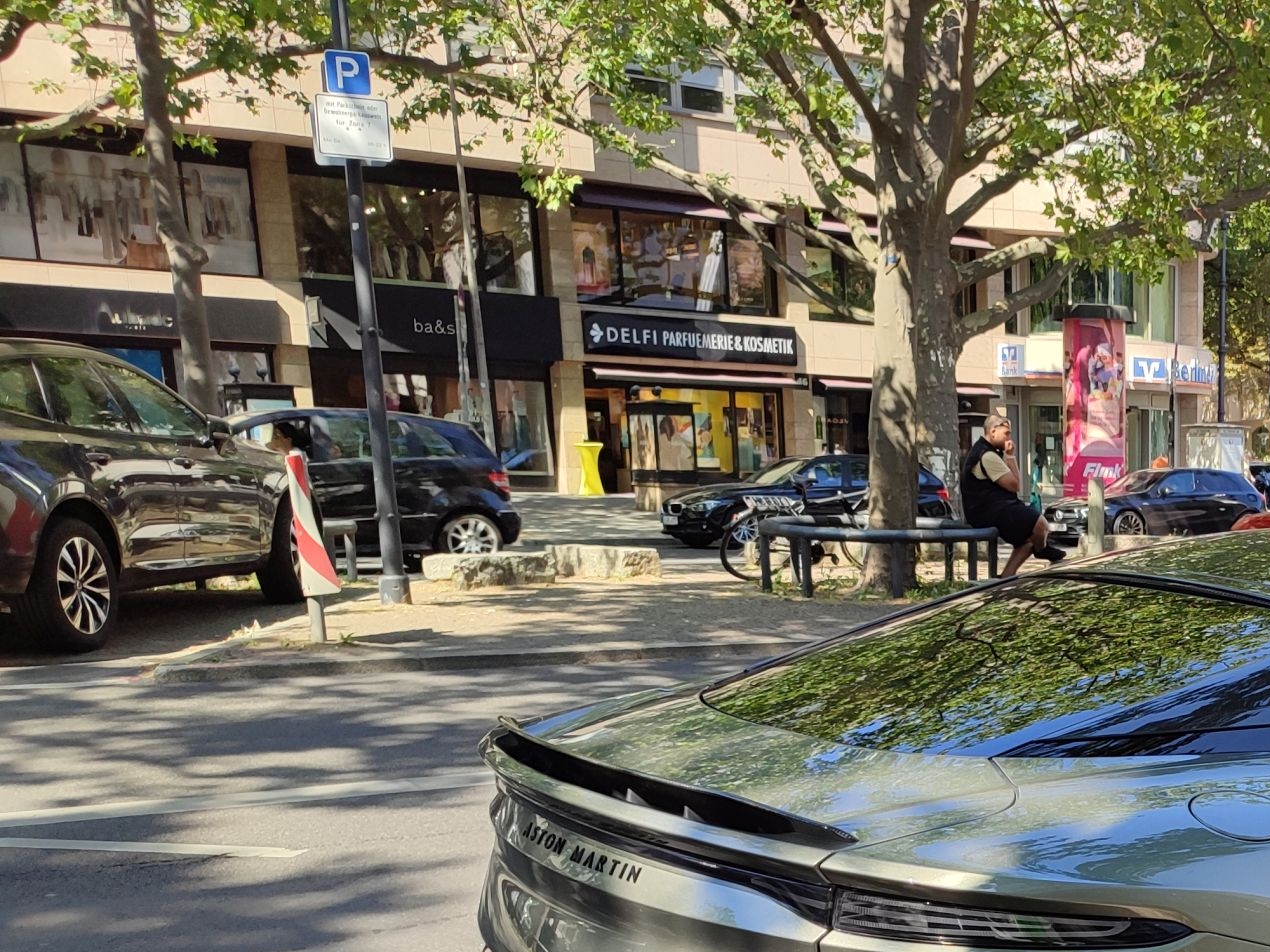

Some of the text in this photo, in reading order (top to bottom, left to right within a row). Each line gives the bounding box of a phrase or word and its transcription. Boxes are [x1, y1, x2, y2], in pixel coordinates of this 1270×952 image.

[335, 56, 360, 89] P
[413, 317, 456, 335] ba&s
[606, 326, 658, 346] DELFI
[522, 822, 642, 883] ASTON MARTIN
